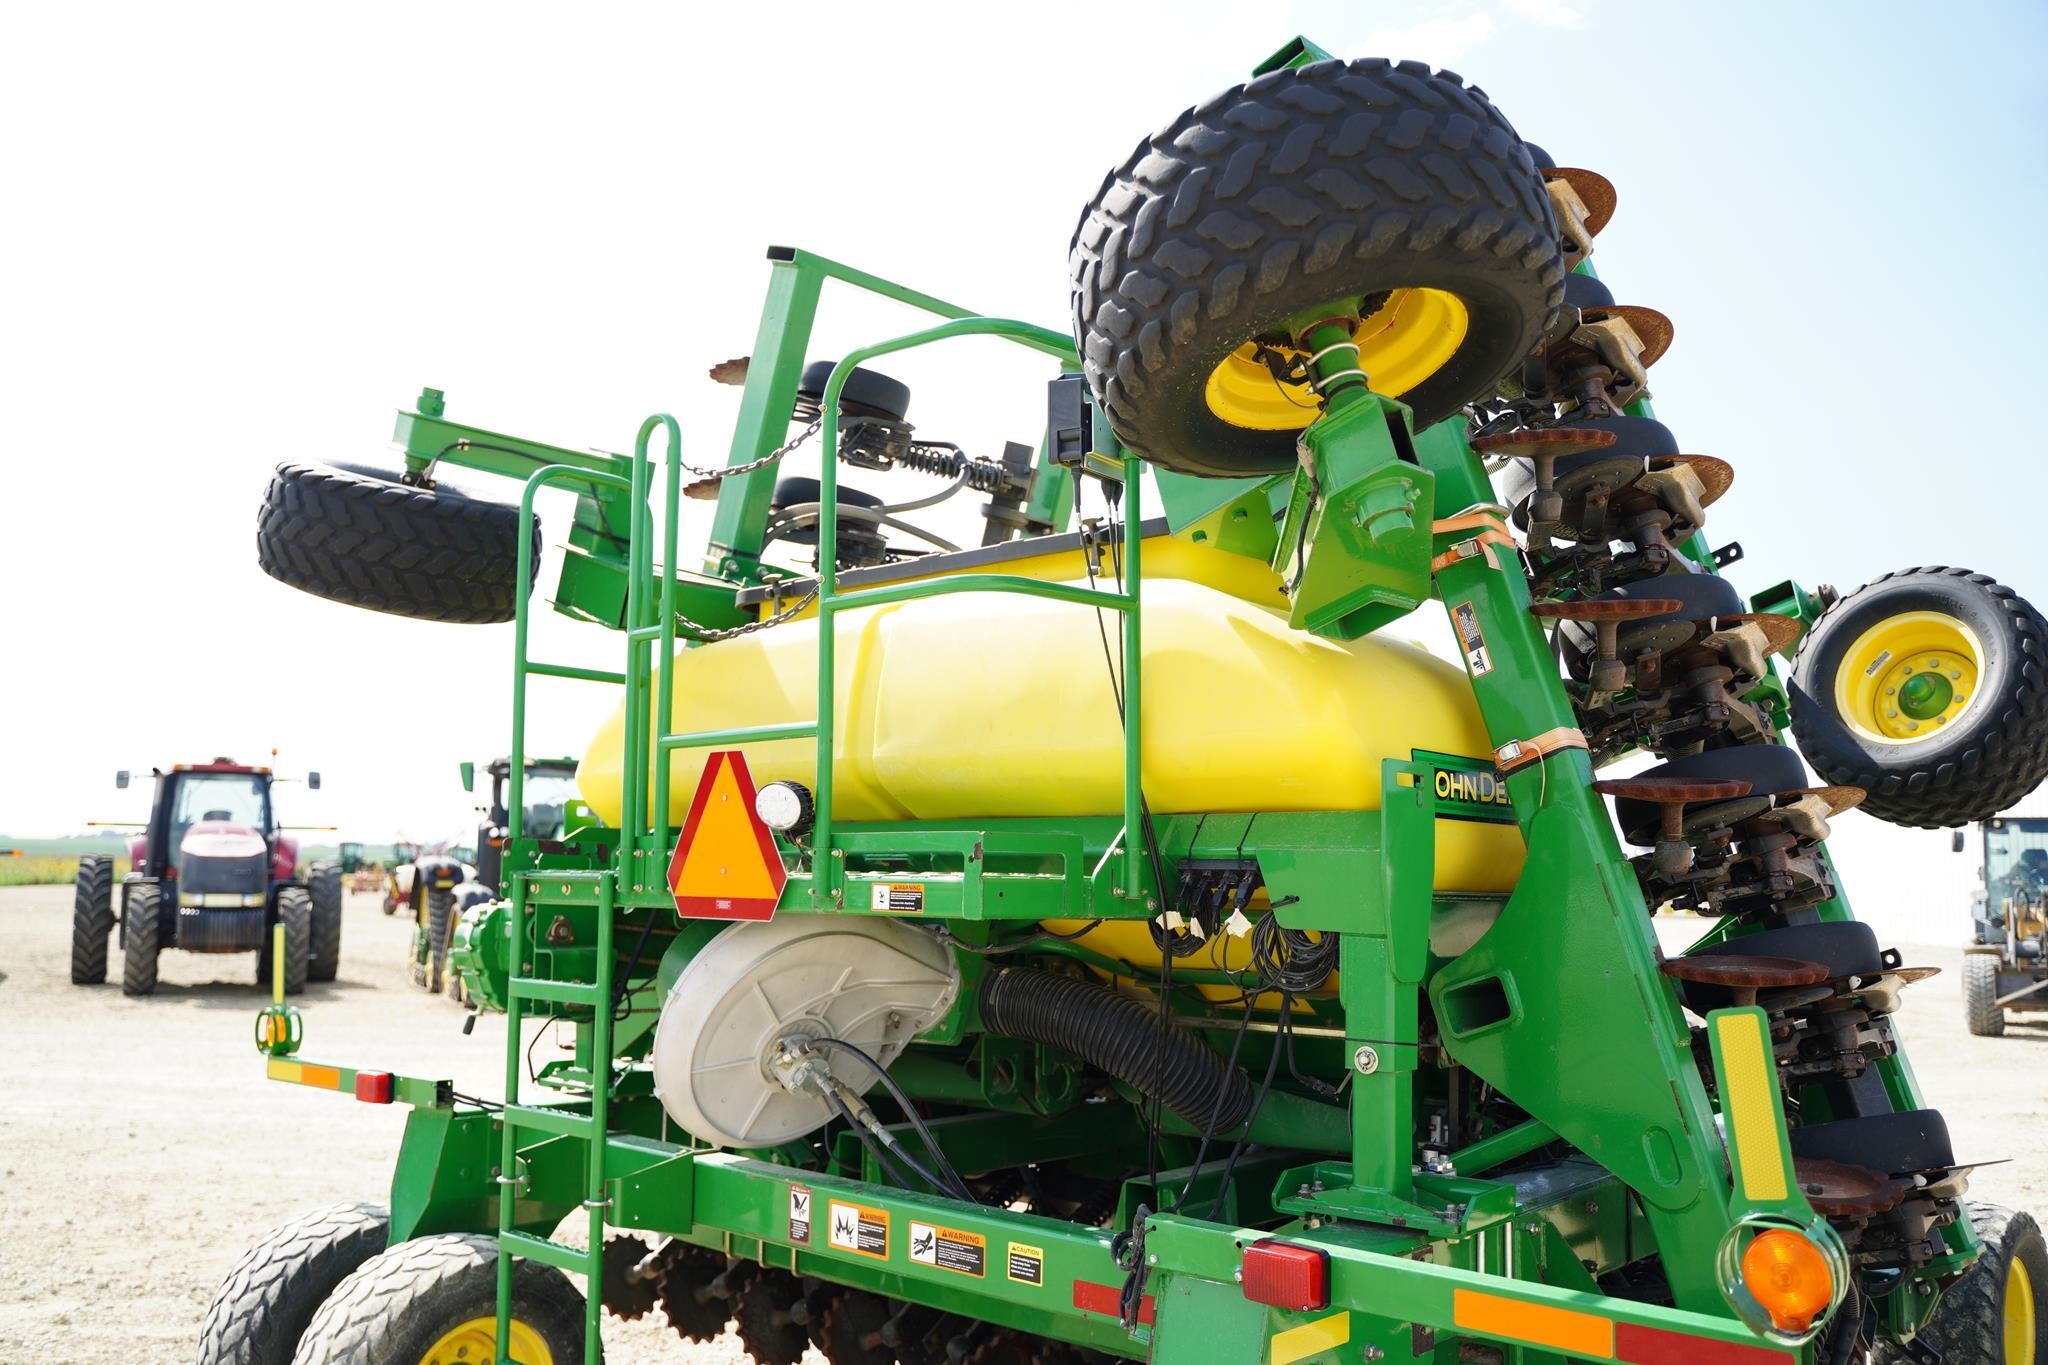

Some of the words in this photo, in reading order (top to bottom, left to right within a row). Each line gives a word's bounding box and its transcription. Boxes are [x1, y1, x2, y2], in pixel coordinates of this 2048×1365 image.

[1436, 771, 1477, 800] OHN
[1480, 772, 1512, 805] DE
[947, 1230, 980, 1245] WARNING
[1016, 1246, 1040, 1256] CAUTION
